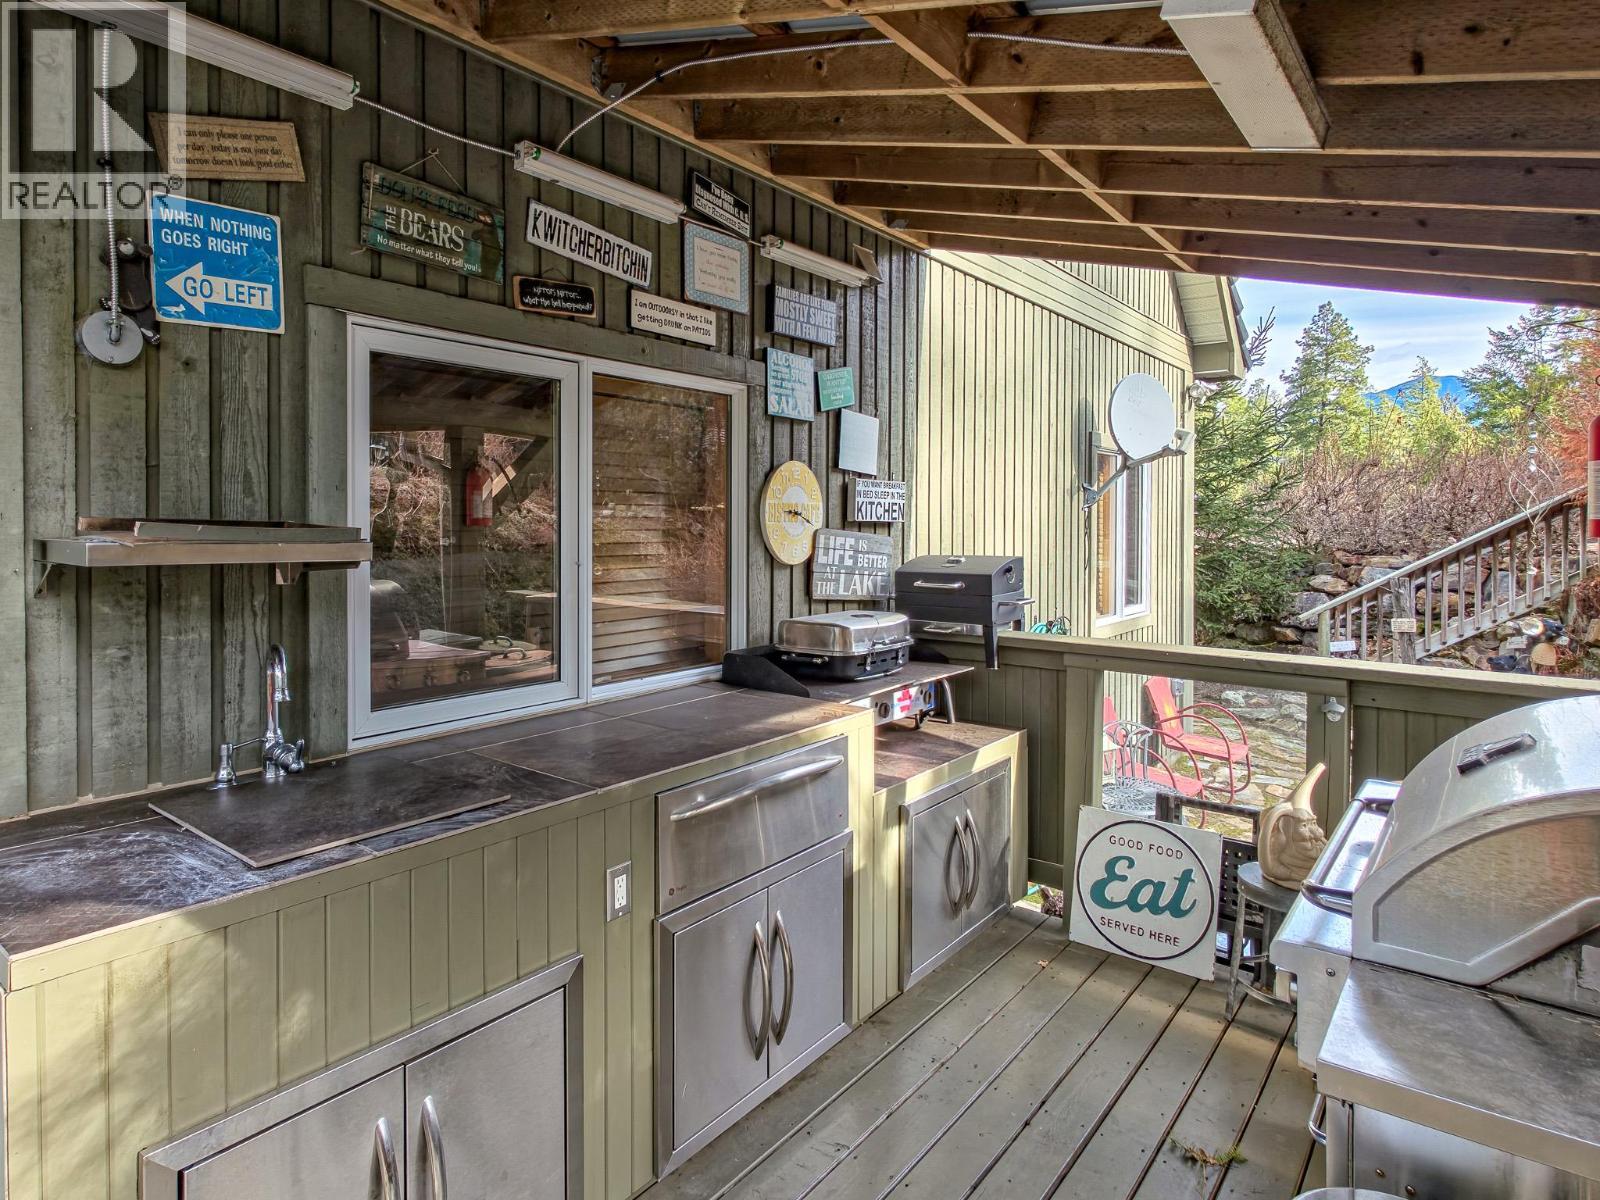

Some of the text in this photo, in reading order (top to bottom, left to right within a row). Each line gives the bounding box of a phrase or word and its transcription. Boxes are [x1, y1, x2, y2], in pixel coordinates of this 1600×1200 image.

[177, 142, 189, 153] per
[211, 144, 233, 155] today
[241, 146, 252, 154] not
[254, 147, 269, 156] your
[198, 129, 214, 141] only
[216, 130, 238, 142] please
[255, 134, 278, 144] person
[174, 156, 210, 165] tomorrow
[212, 157, 238, 167] doesn't
[239, 158, 255, 167] look
[257, 159, 273, 170] good
[159, 208, 272, 241] WHEN NOTHING
[384, 204, 397, 230] THE
[399, 208, 465, 251] BEARS
[161, 228, 249, 257] GOES RIGHT
[377, 234, 388, 244] No
[388, 239, 415, 253] matter
[416, 247, 434, 259] what
[435, 252, 450, 266] they
[452, 257, 464, 267] tell
[183, 276, 268, 306] GO LEFT
[775, 284, 799, 302] FAMILIES
[799, 291, 810, 305] ARE
[810, 295, 821, 308] LIKE
[637, 313, 663, 327] getting
[692, 326, 711, 337] PATIOS
[639, 300, 647, 309] am
[648, 302, 679, 316] OUTDOORSY
[686, 312, 699, 321] that
[703, 317, 713, 326] like
[775, 297, 837, 330] MOSTLY SWEET
[774, 315, 836, 346] WITH A FEW NUTS
[857, 490, 906, 500] IN BED SLEEP IN THE
[862, 480, 870, 488] YOU
[871, 481, 883, 489] WANT
[883, 482, 905, 490] BREAKFAST
[857, 501, 905, 521] KITCHEN
[818, 534, 855, 566] LIFE
[858, 539, 868, 551] IS
[823, 566, 838, 579] AT
[857, 554, 888, 569] BETTER
[816, 569, 887, 596] THE LAKE
[1109, 835, 1184, 860] GOOD FOOD
[1089, 855, 1197, 919] Eat
[1100, 916, 1181, 947] SERVED HERE
